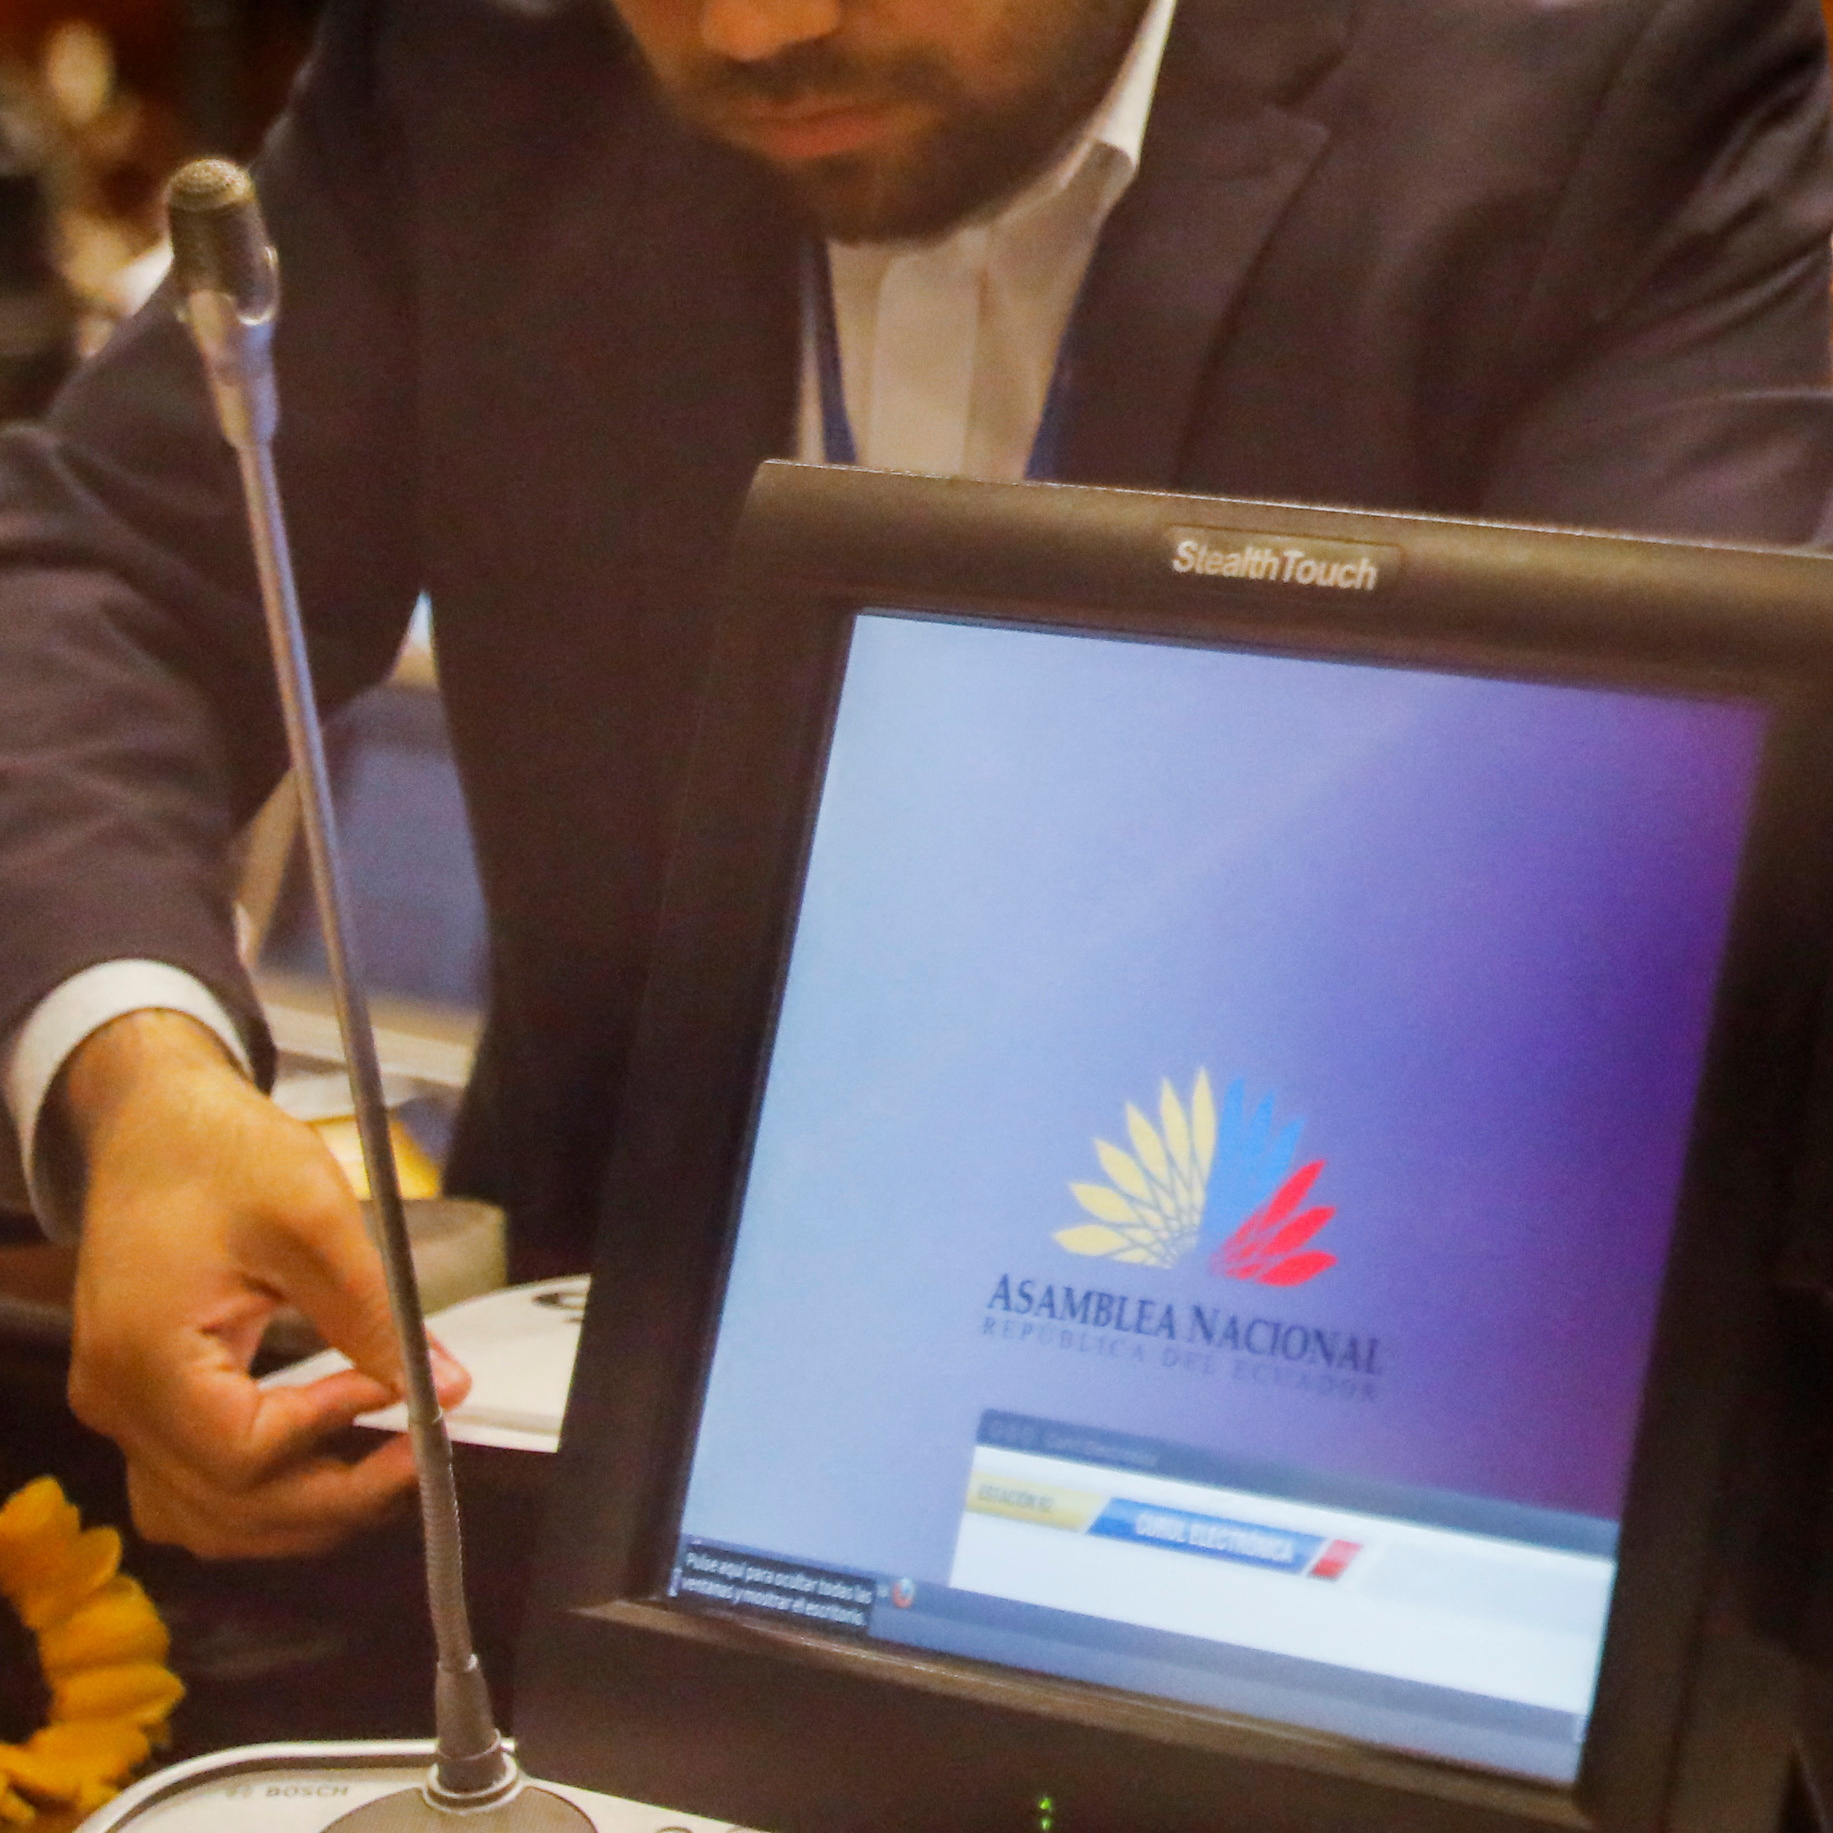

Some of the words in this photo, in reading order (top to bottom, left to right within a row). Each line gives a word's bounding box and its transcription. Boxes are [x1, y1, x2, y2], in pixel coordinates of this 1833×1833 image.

[1172, 540, 1379, 590] StealthTouch
[986, 1273, 1177, 1341] ASAMBLEA
[1186, 1303, 1382, 1376] NACIONAL
[265, 1784, 349, 1798] BOSCH
